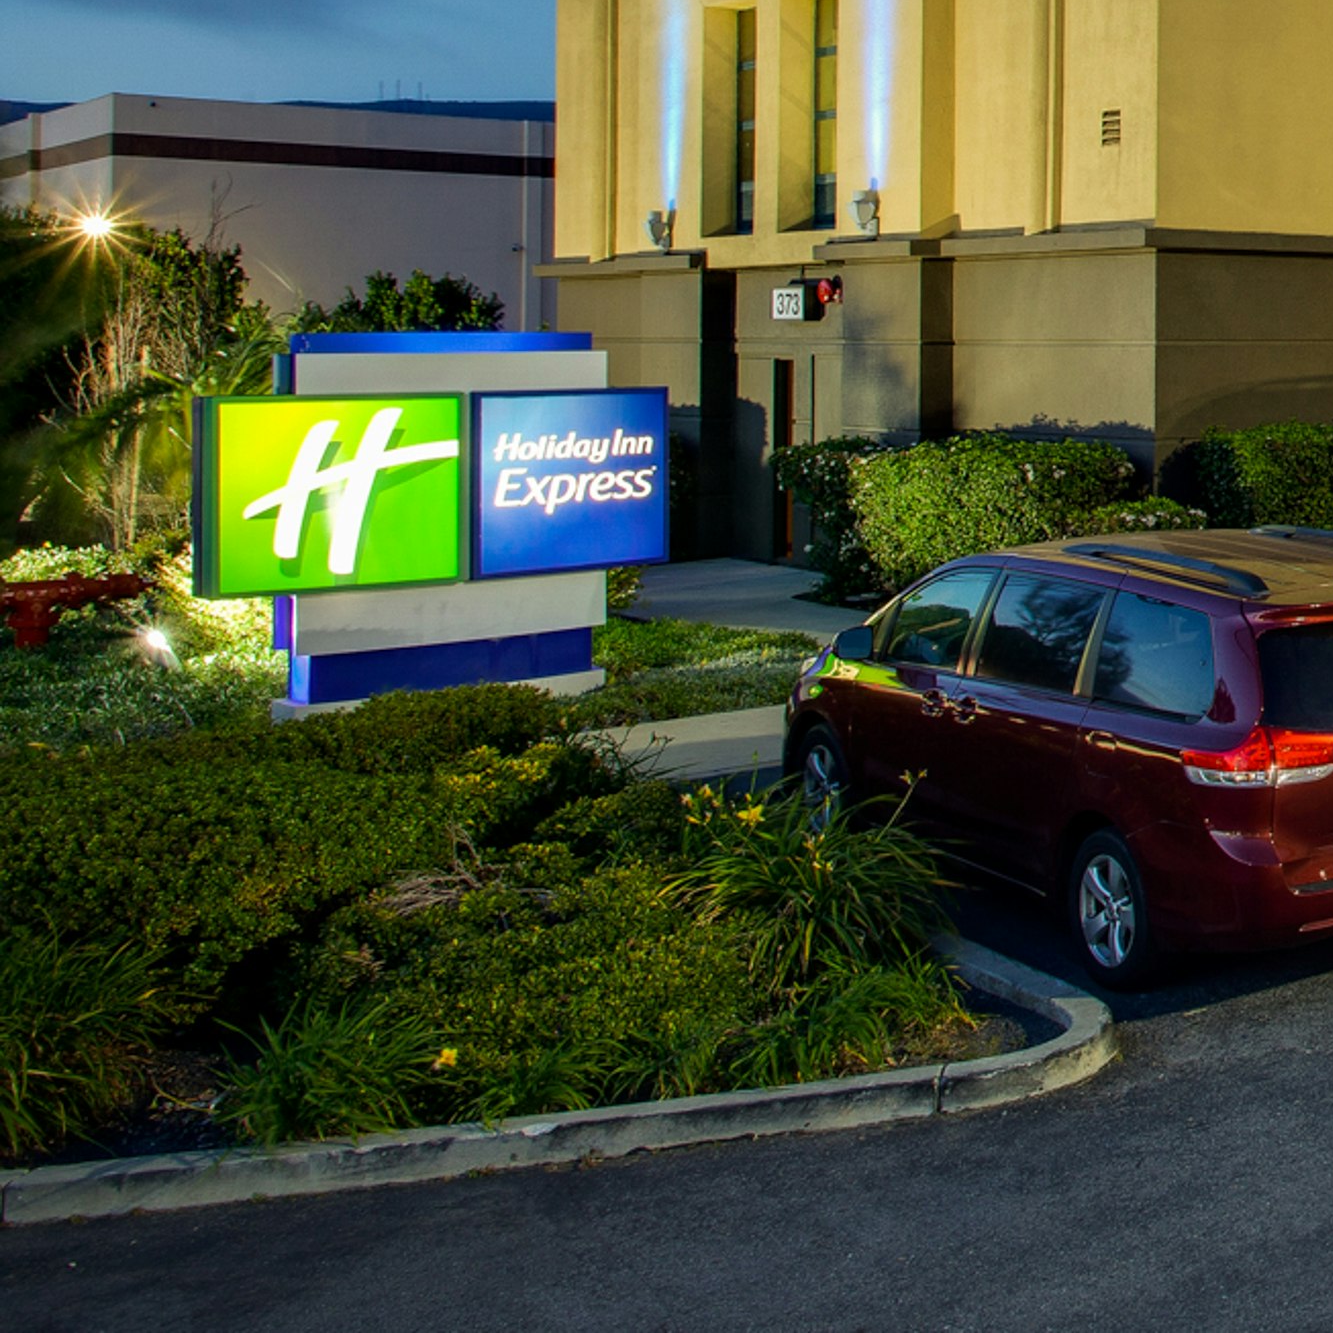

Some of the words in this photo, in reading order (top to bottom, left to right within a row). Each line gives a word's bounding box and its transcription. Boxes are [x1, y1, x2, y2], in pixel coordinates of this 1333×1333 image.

[776, 293, 800, 316] 373
[493, 431, 610, 464] Holiday
[611, 428, 654, 456] Inn
[493, 467, 654, 515] Express
